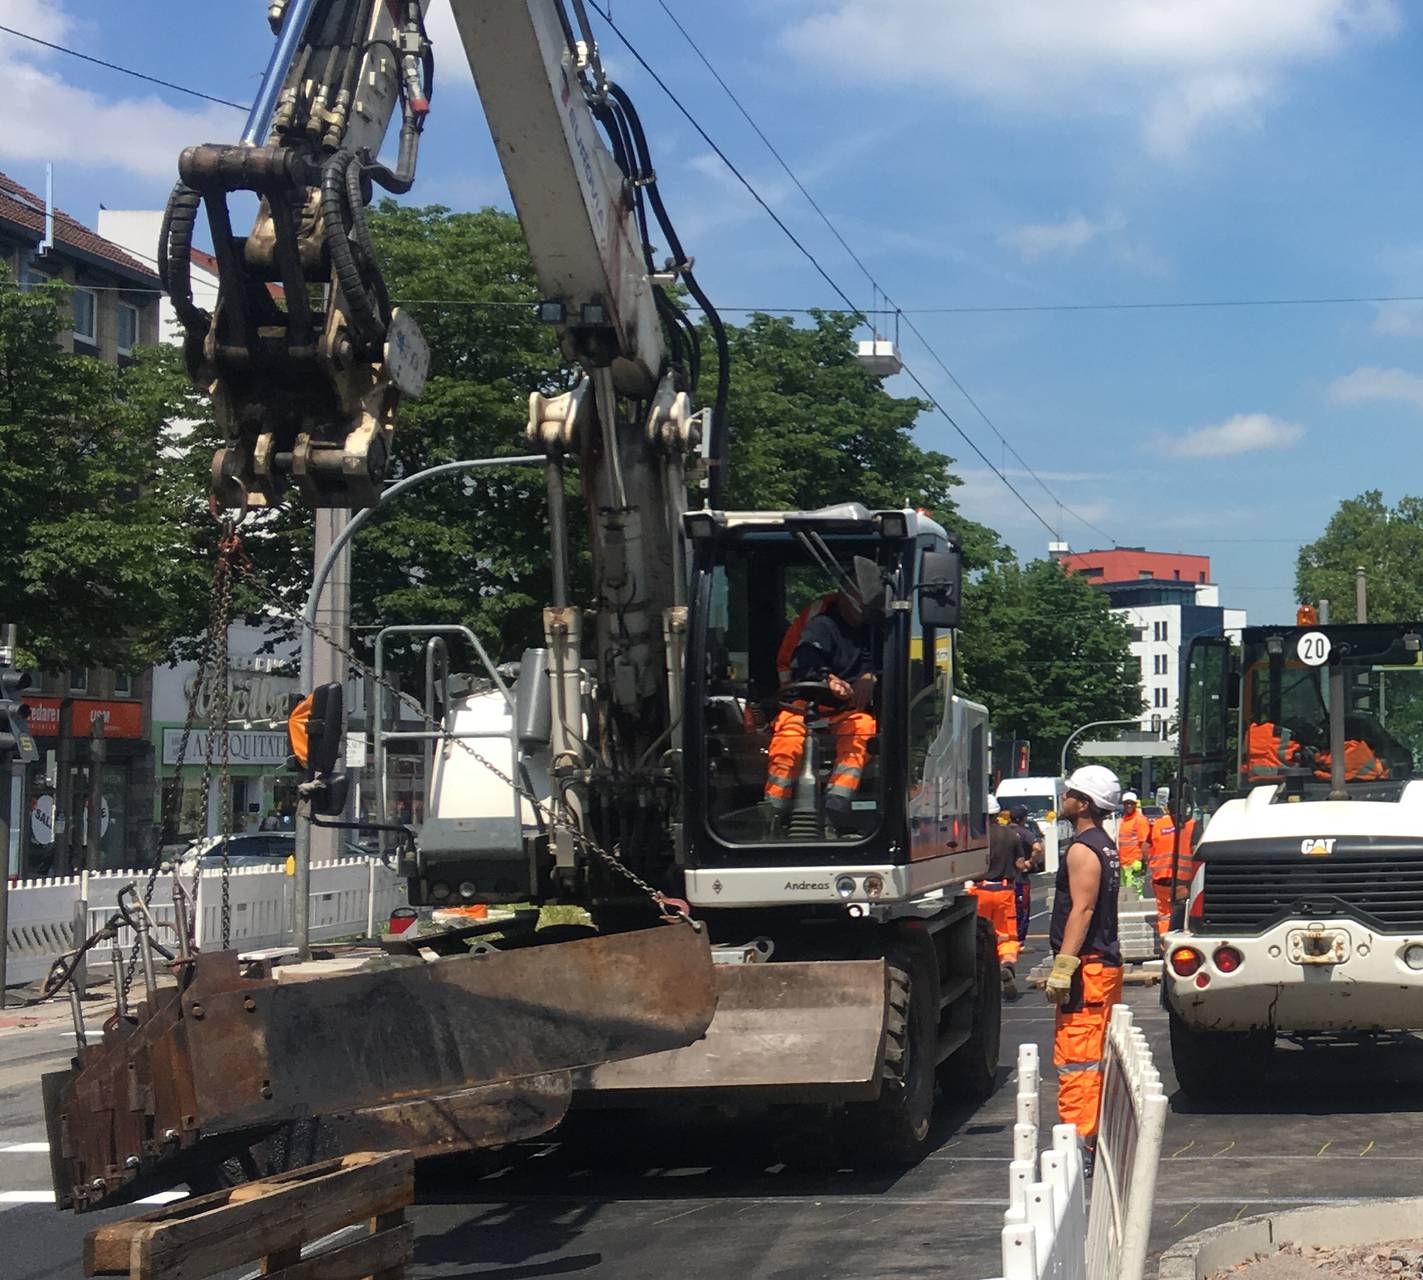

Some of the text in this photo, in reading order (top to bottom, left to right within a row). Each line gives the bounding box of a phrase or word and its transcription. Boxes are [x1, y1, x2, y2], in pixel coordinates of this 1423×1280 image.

[1304, 638, 1325, 660] 20
[1301, 838, 1337, 855] CAT
[784, 881, 830, 890] Andreas
